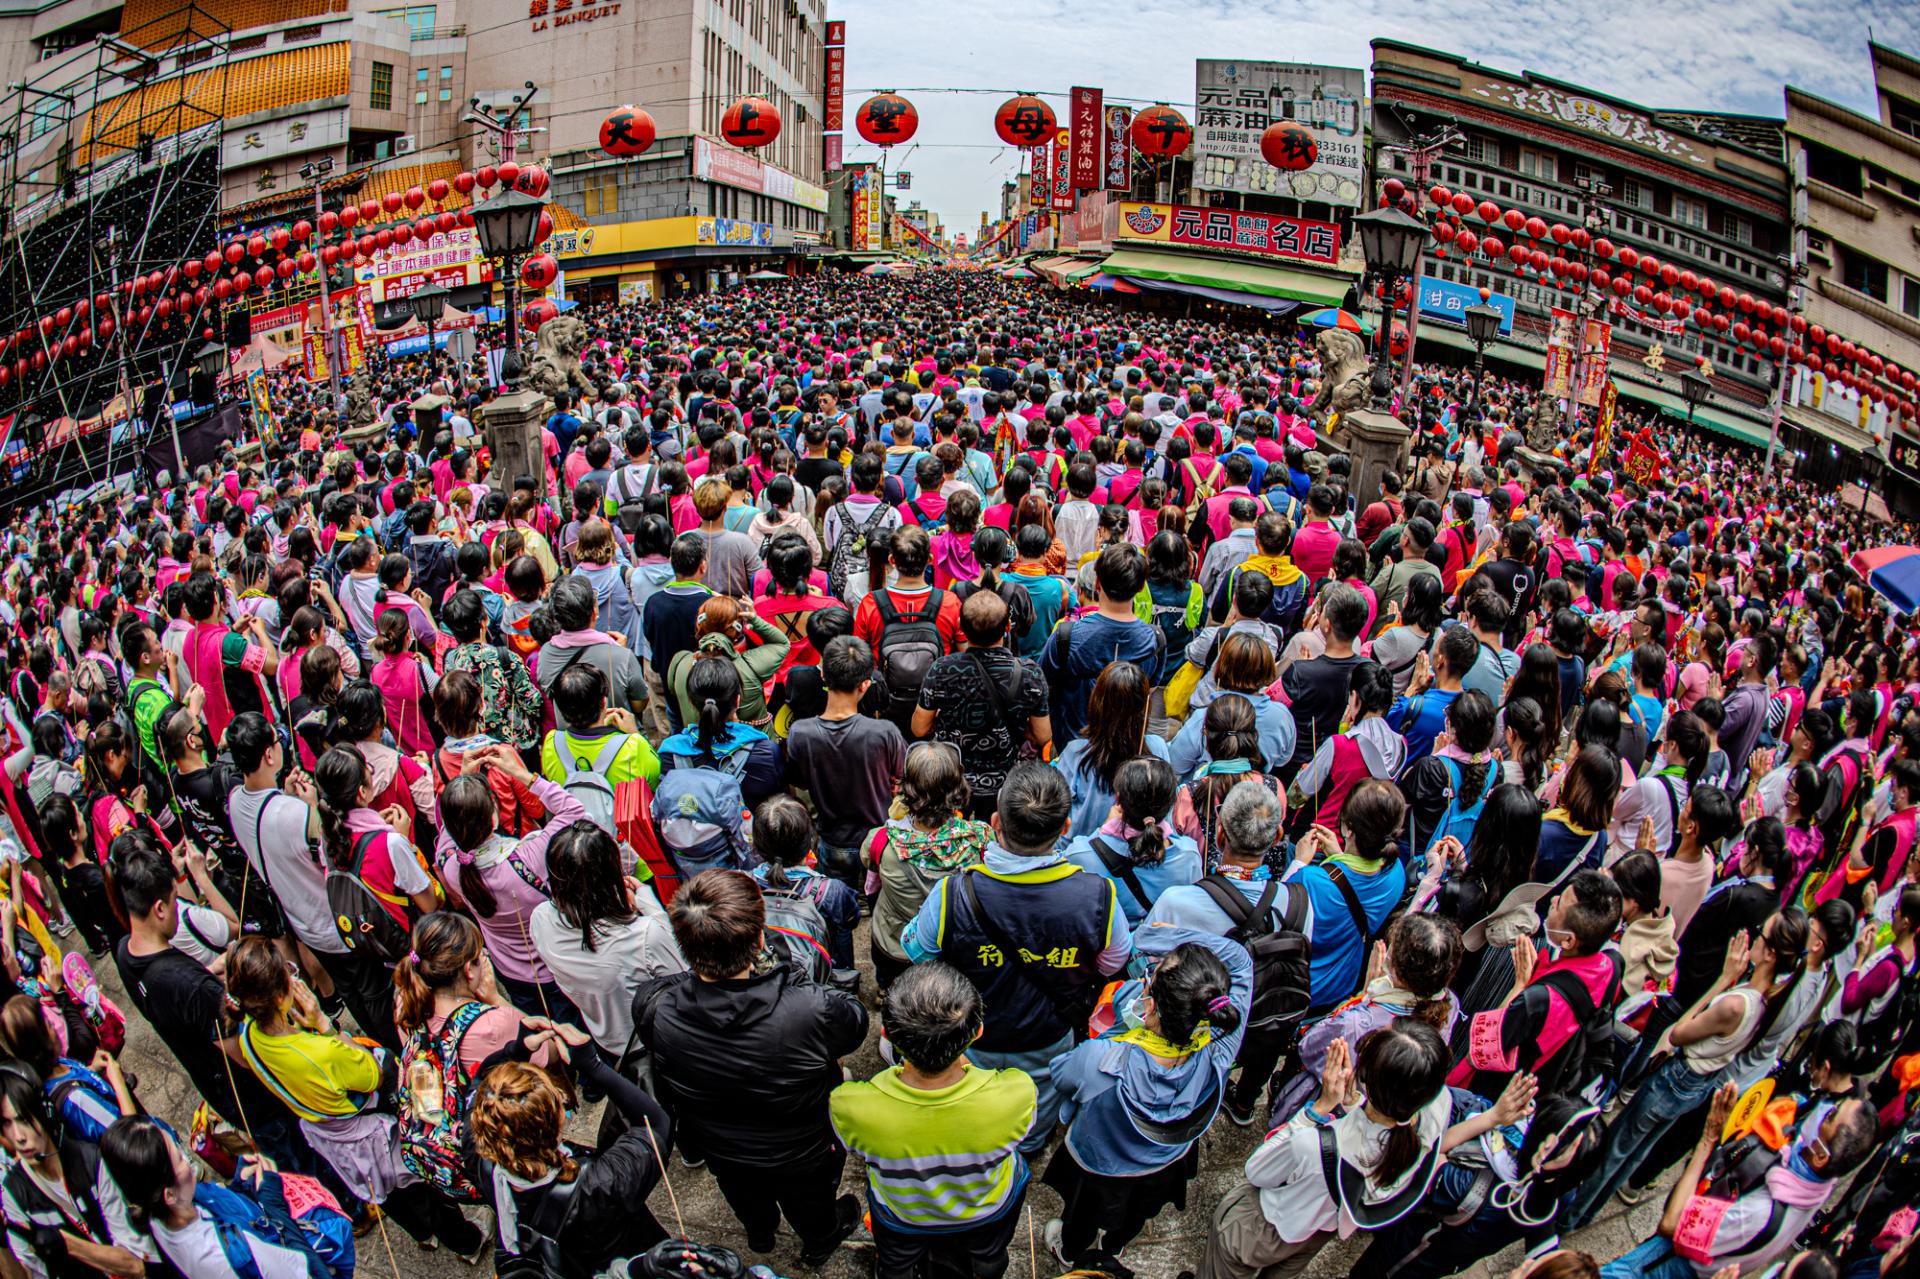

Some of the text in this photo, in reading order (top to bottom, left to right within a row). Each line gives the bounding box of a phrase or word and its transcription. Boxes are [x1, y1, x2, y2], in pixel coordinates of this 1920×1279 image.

[532, 4, 621, 32] LA BANQUET
[831, 49, 841, 96] 朝聖酒店
[1199, 87, 1268, 109] 元品
[605, 99, 1314, 165] 天 上 聖 母 千 秋
[1206, 131, 1249, 144] 自用送禮
[1175, 209, 1233, 243] 元品
[1272, 221, 1334, 258] 名店
[525, 262, 545, 282] 雨
[386, 276, 465, 300] 即將在服務
